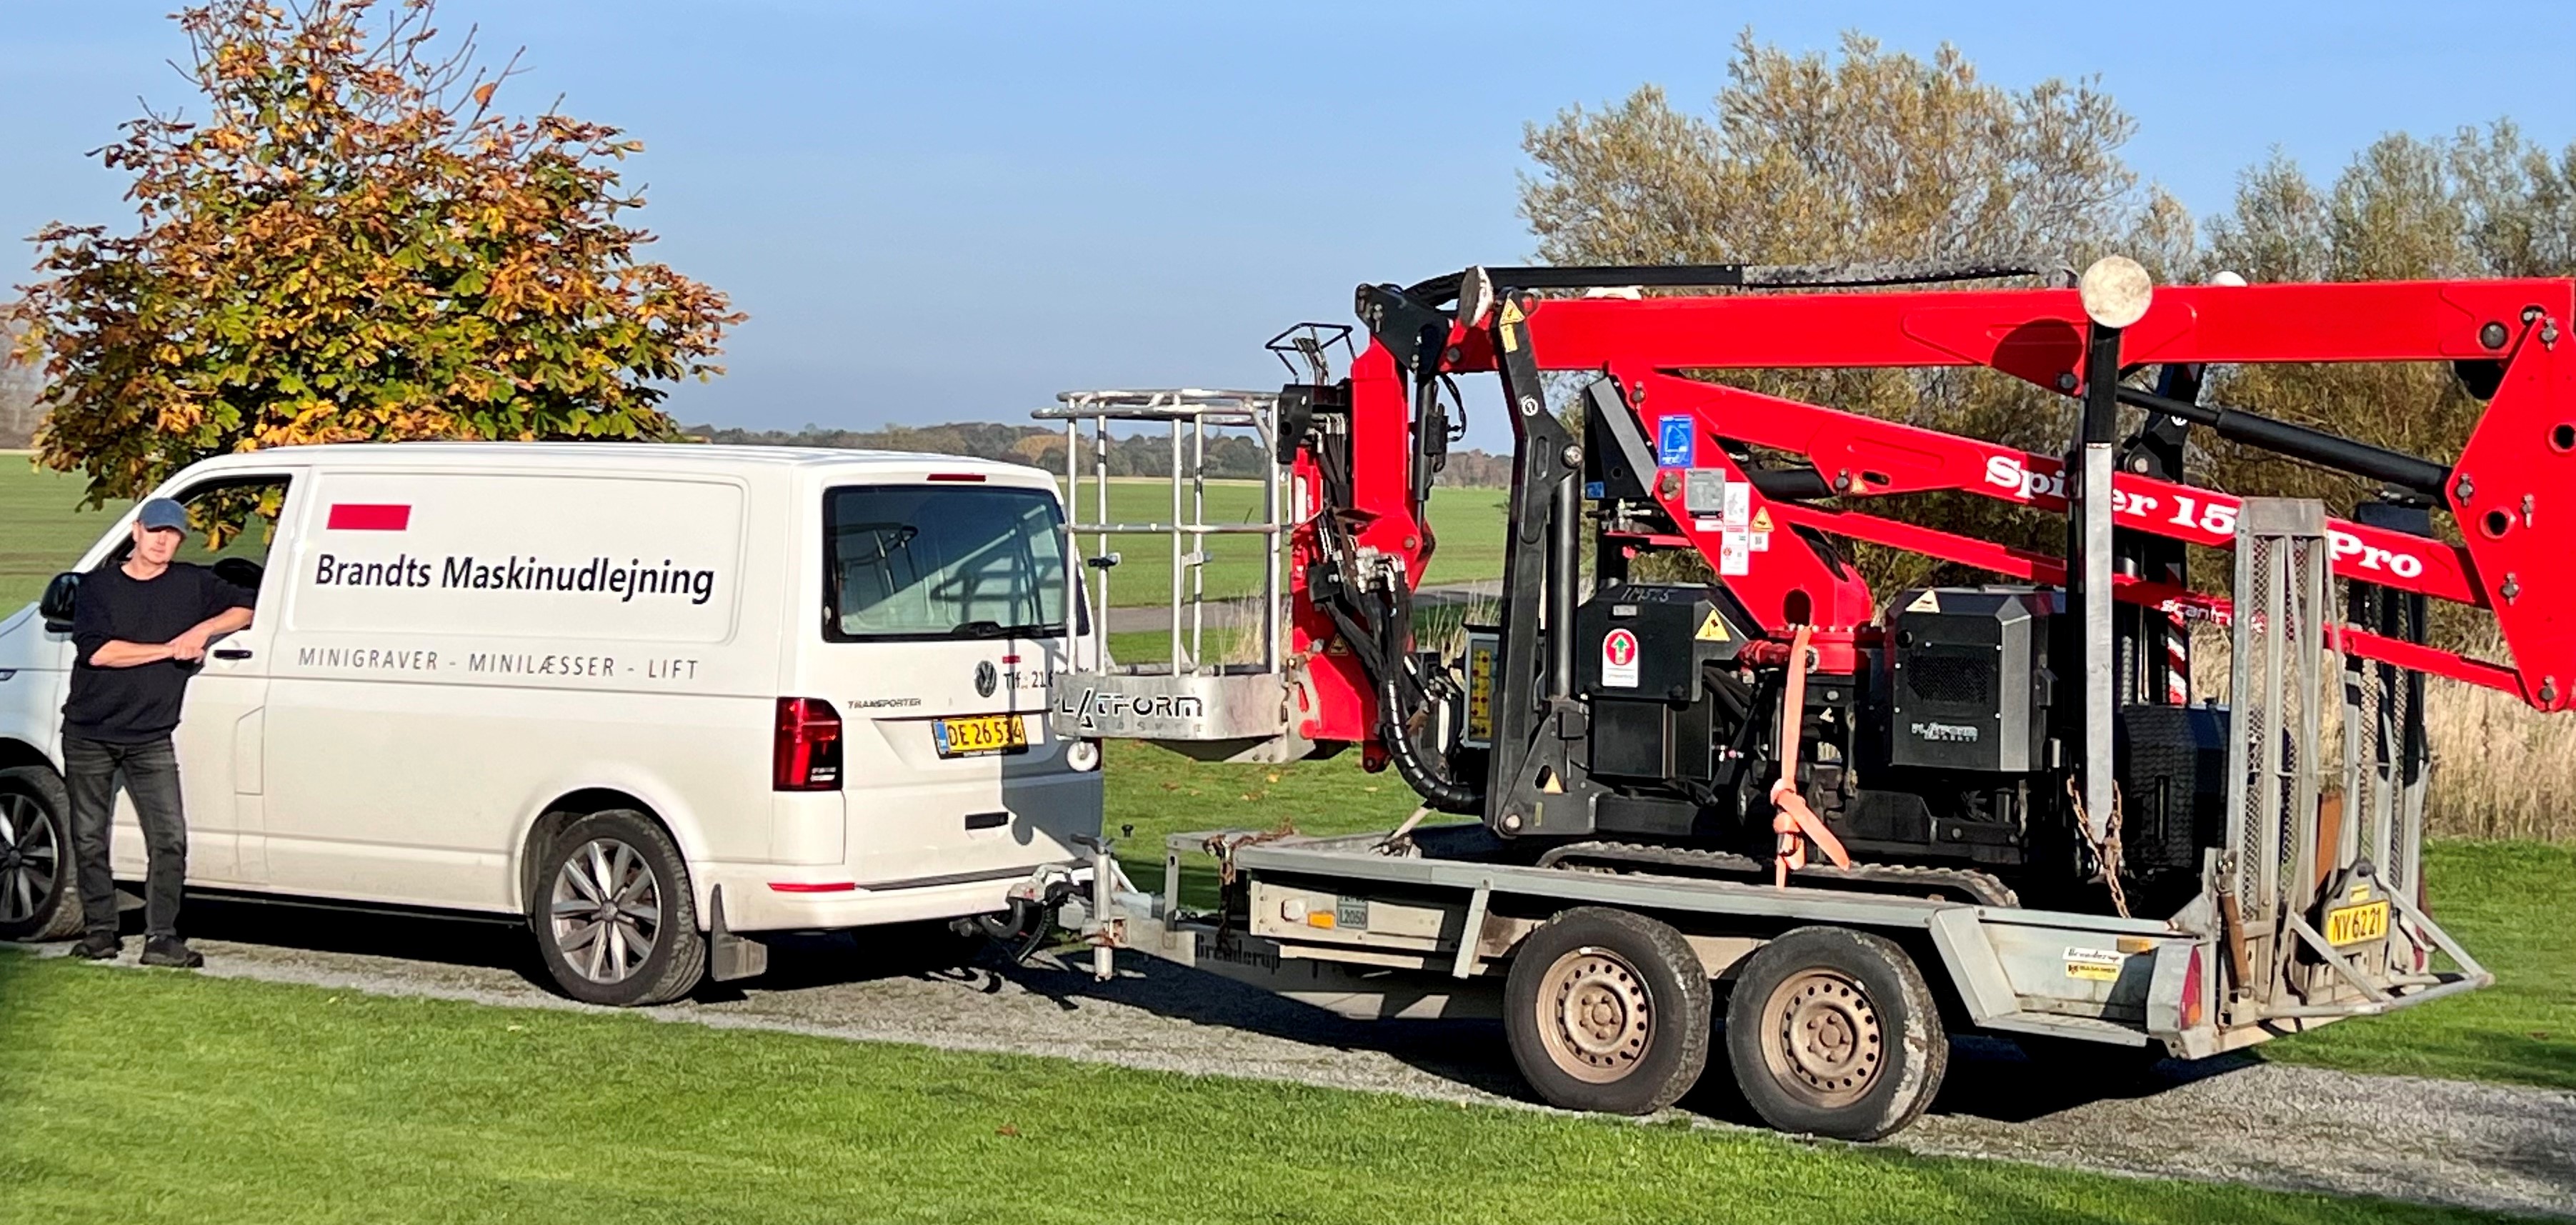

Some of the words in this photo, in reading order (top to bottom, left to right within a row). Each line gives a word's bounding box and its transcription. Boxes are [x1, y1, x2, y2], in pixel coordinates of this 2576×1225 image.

[1985, 455, 2158, 517] Spier
[2327, 529, 2423, 578] Pro
[316, 554, 431, 588] Brandts
[441, 555, 714, 605] Maskinudlejning
[299, 647, 438, 670] MINIGRAVER
[469, 653, 614, 677] MINILÆSSER
[648, 659, 699, 679] LIFT
[848, 698, 922, 709] TRANSPORTER
[947, 724, 970, 746] DE
[972, 721, 992, 744] 26
[2352, 907, 2381, 939] 6221
